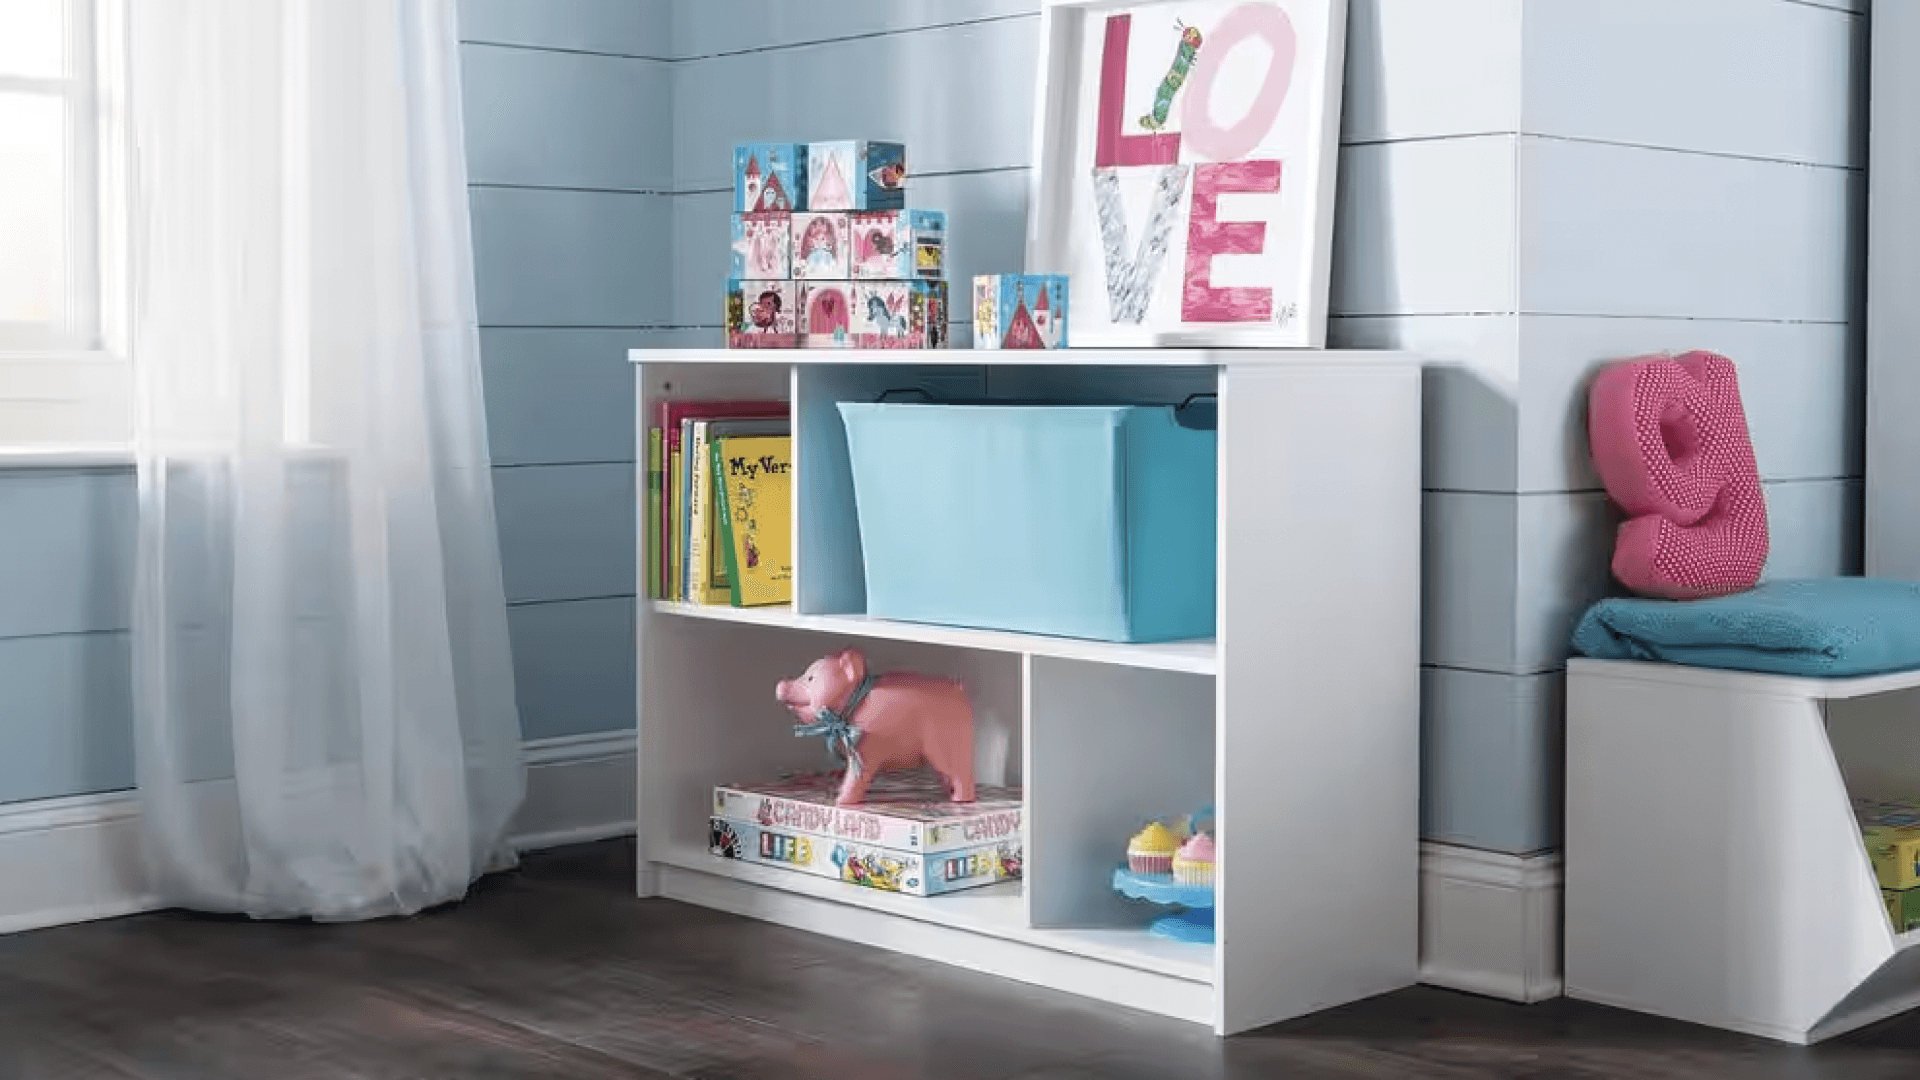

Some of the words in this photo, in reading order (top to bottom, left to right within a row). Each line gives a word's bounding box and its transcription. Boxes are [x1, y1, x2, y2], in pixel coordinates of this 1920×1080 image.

[729, 456, 758, 479] My
[759, 455, 791, 473] Ver
[760, 831, 813, 866] LIFE
